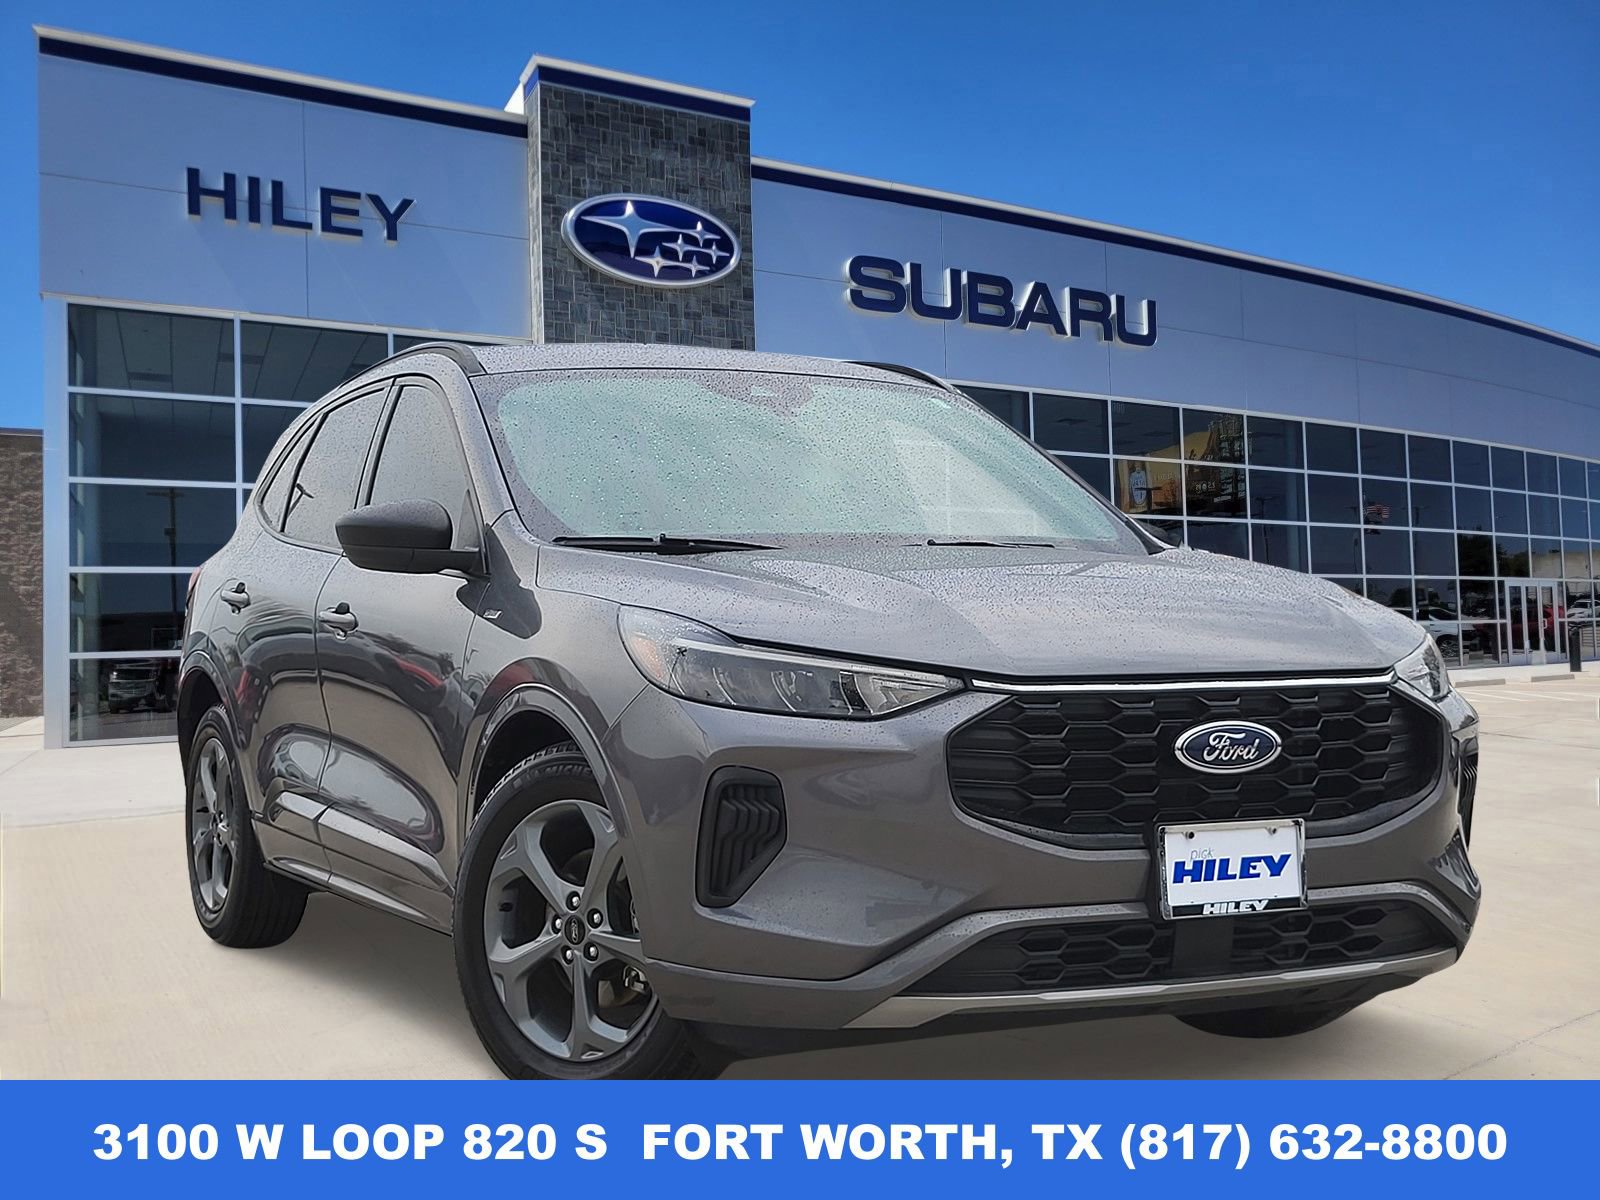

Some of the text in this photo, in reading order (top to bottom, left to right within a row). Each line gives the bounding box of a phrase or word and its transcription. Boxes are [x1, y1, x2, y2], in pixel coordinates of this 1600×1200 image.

[186, 166, 416, 244] HILEY
[847, 254, 1158, 347] SUBARU
[1203, 731, 1260, 762] Ford
[1172, 853, 1292, 884] HILEY
[1202, 899, 1269, 915] HILEY
